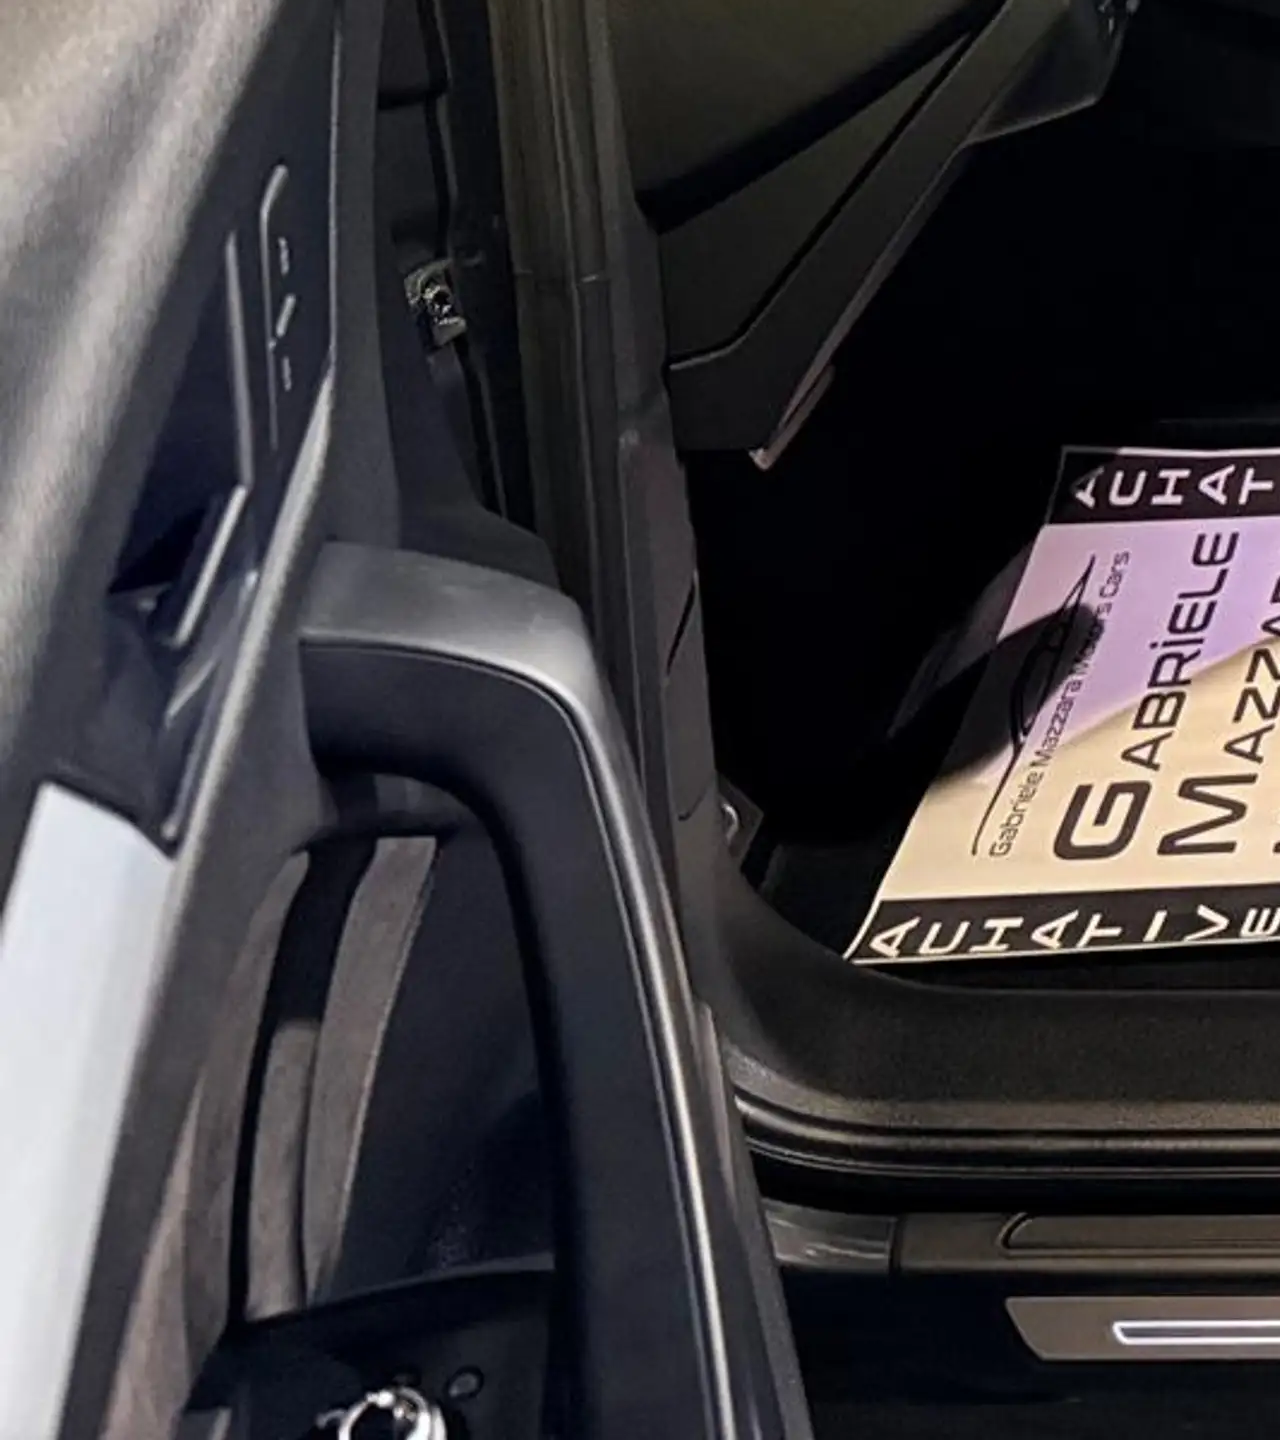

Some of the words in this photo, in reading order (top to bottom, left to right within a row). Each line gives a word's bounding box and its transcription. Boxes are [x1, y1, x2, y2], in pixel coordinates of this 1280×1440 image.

[988, 769, 1044, 858] Gabriele
[1034, 679, 1083, 767] Mazzara
[1099, 550, 1130, 599] Cars
